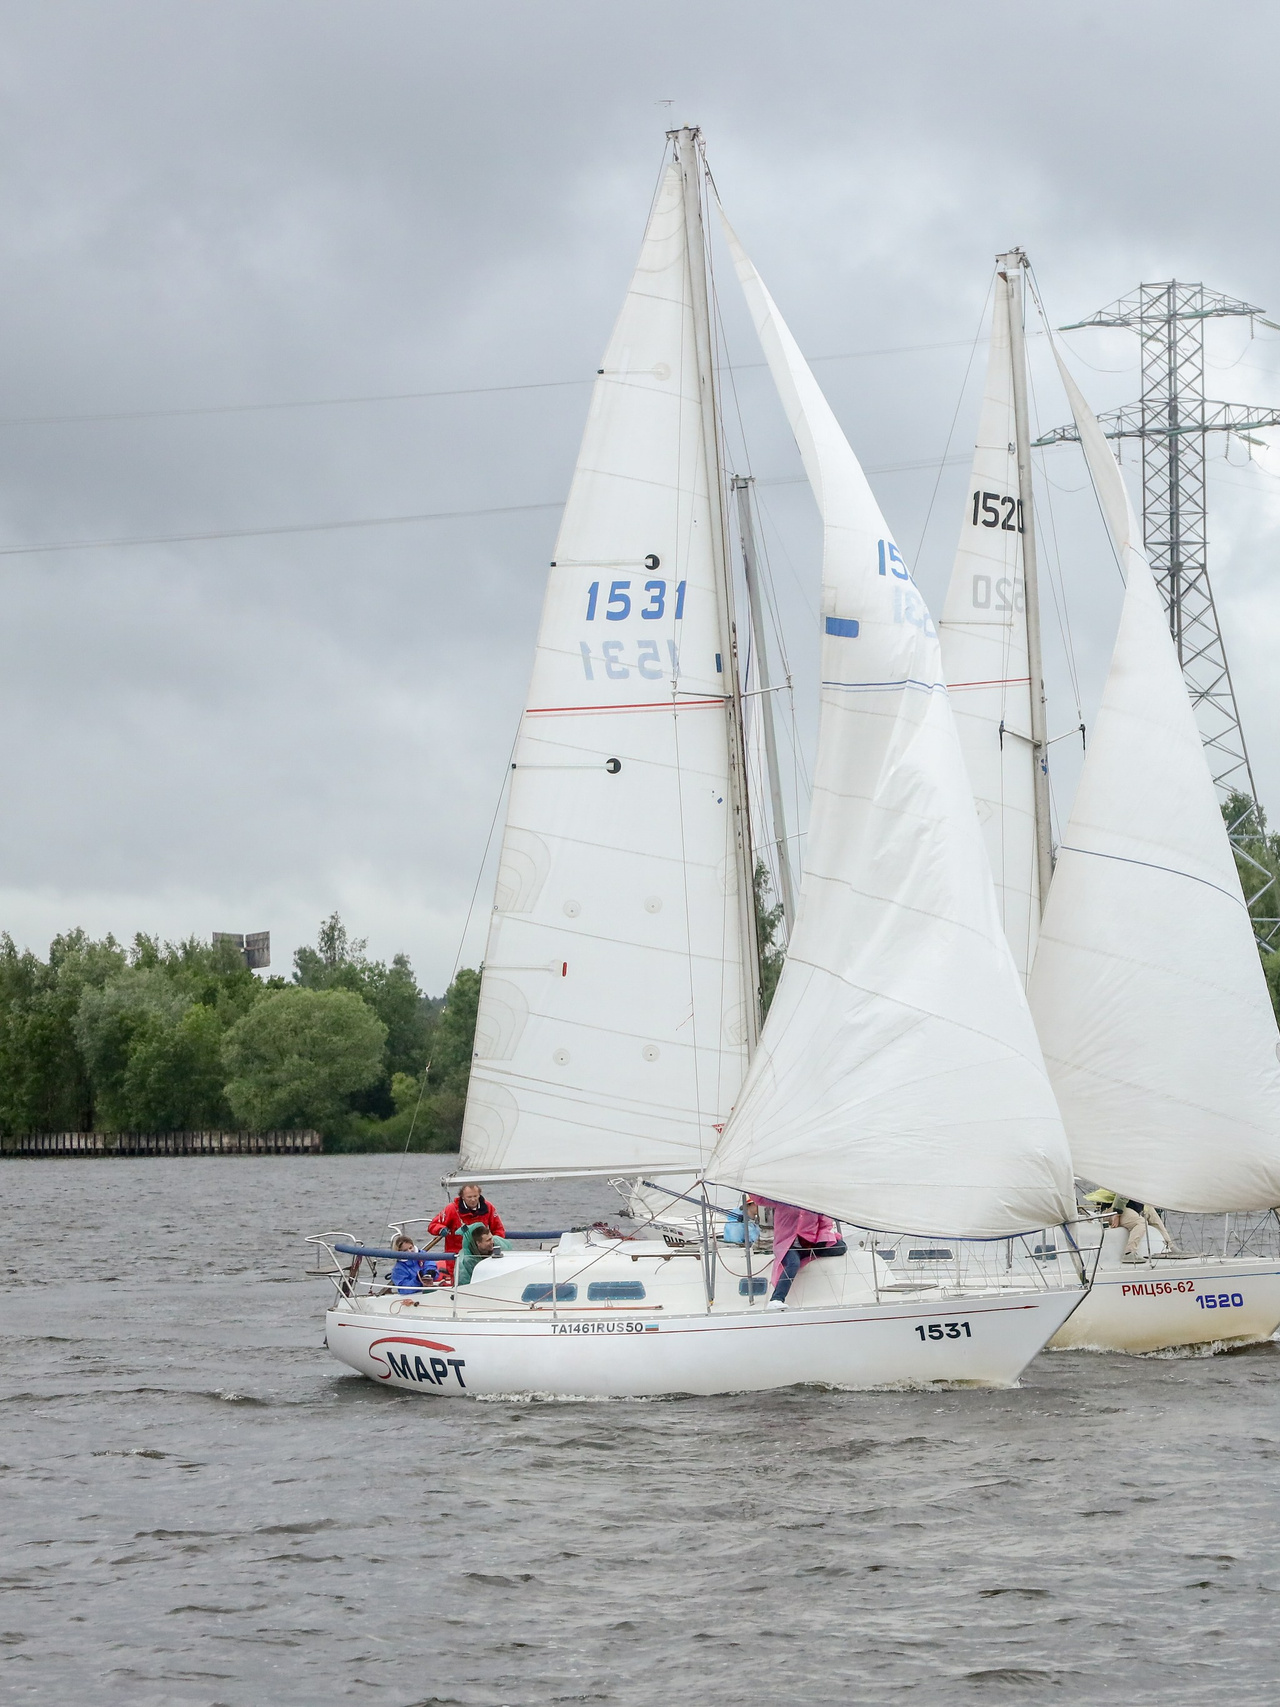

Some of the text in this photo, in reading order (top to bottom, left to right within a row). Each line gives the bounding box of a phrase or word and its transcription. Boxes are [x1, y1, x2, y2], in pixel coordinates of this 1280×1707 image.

[972, 490, 1024, 534] 1520
[877, 539, 915, 585] 15
[586, 580, 687, 621] 1531
[1121, 1281, 1195, 1298] РМЦ56-62
[1196, 1293, 1243, 1309] 1520
[915, 1321, 973, 1342] 1531
